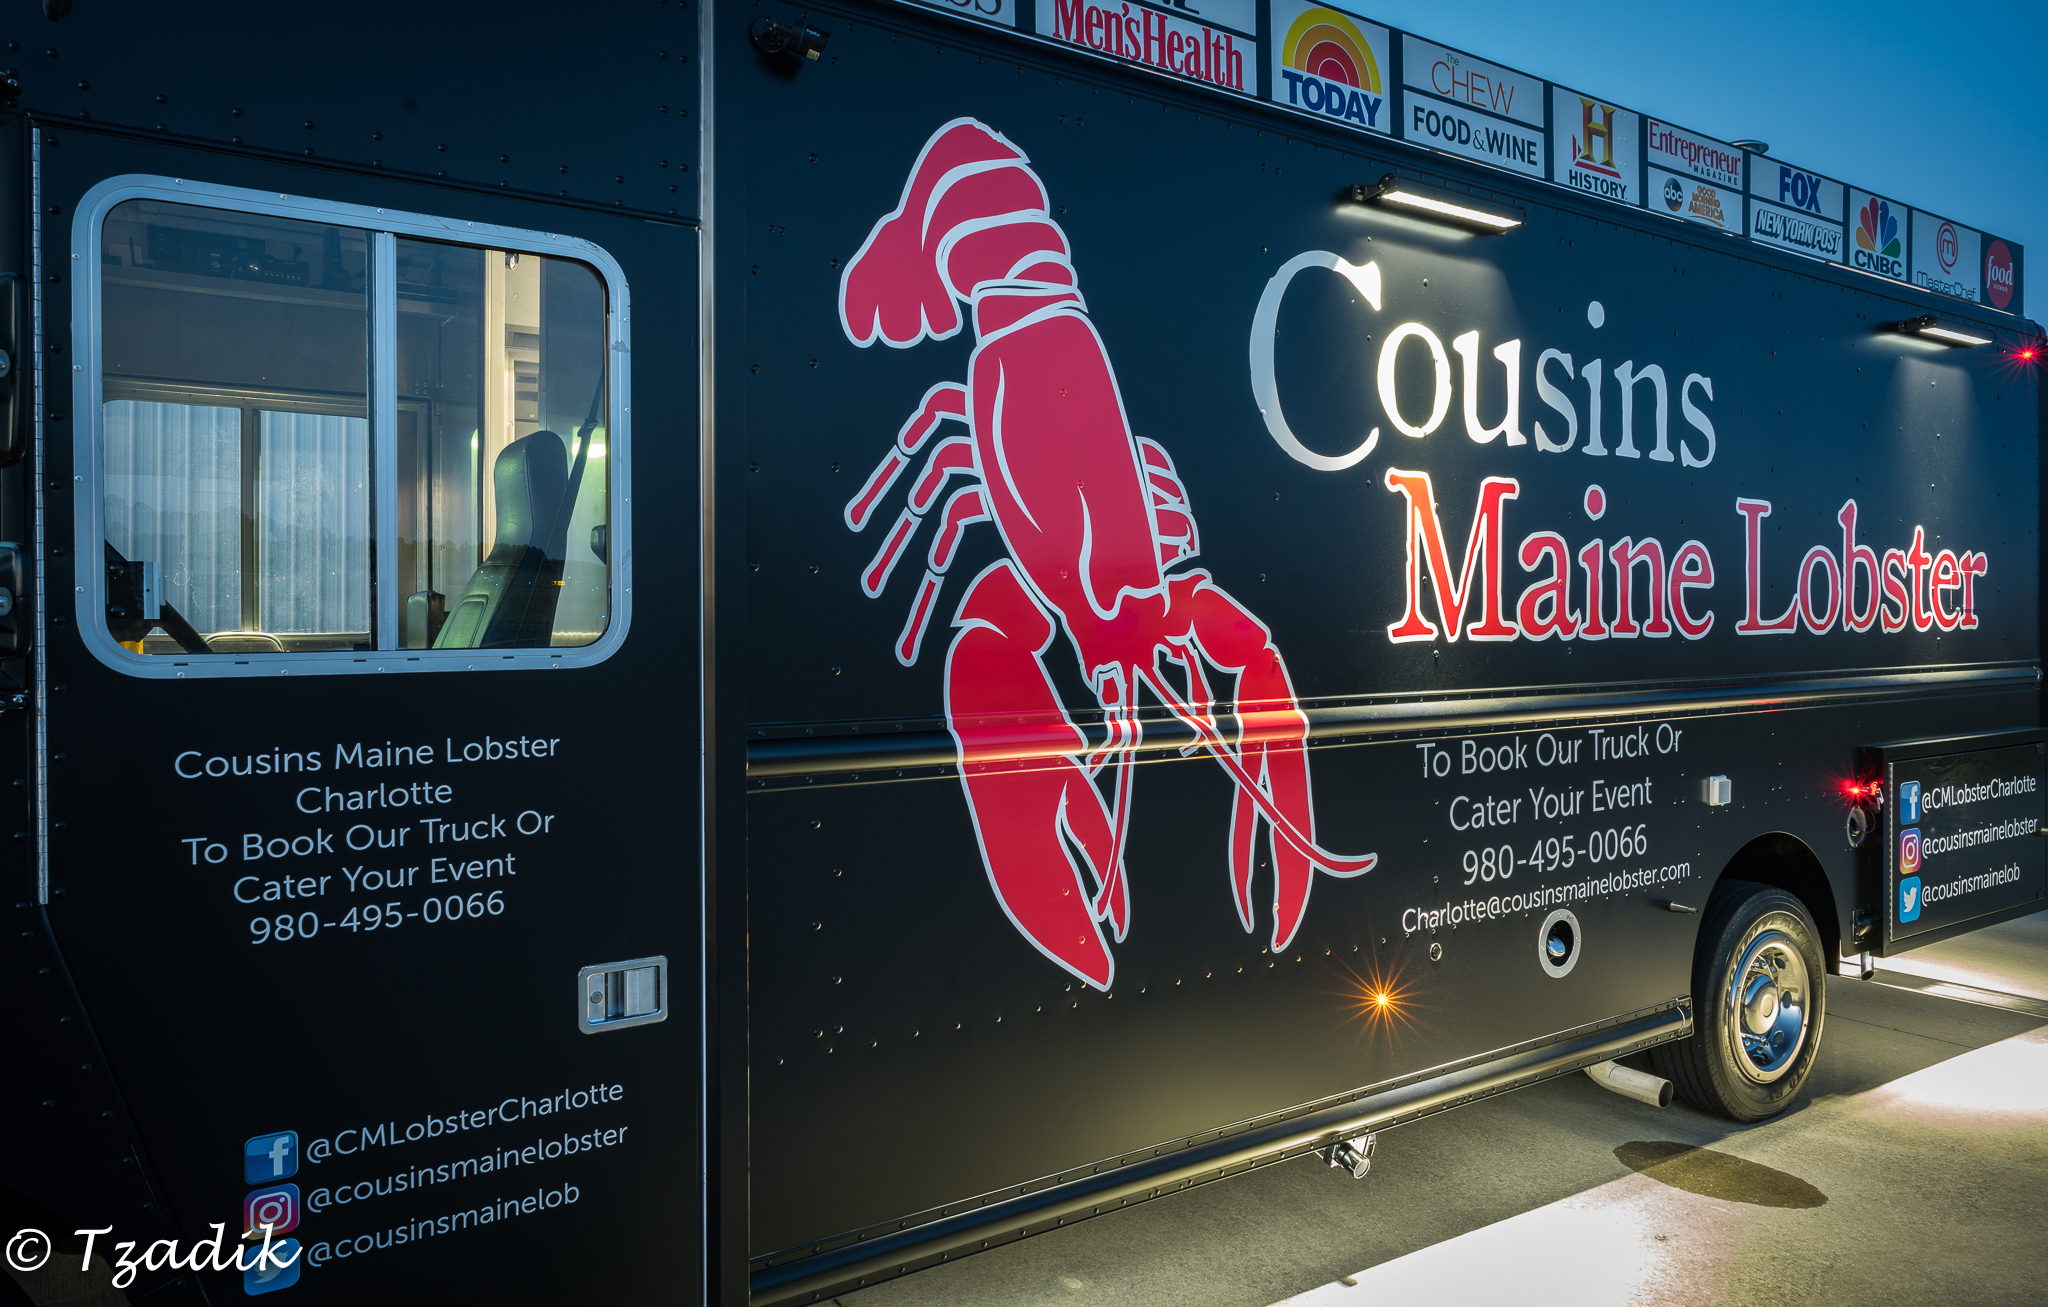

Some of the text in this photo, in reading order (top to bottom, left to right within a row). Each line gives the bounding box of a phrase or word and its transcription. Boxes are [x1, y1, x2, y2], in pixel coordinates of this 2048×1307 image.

[1445, 53, 1460, 66] The
[1282, 69, 1382, 127] TODAY
[1431, 60, 1515, 115] CHEW
[1648, 120, 1742, 175] Entrepreneur
[1568, 169, 1628, 200] HISTORY
[1664, 185, 1683, 203] abc
[1693, 164, 1738, 186] MAGAZINE
[1696, 184, 1716, 199] GOOD
[1779, 165, 1822, 214] FOX
[1687, 200, 1725, 222] AMERICA
[1692, 192, 1721, 209] MORNING
[1755, 209, 1842, 256] NEW YORK POST
[1854, 250, 1903, 278] CNBC
[1986, 255, 2013, 289] food
[1993, 283, 2009, 293] network
[1249, 250, 1716, 471] Cousins
[1384, 466, 1988, 644] Maine Lobster
[174, 735, 560, 779] Cousins Maine Lobster
[1416, 723, 1683, 778] To Book Our Truck Or
[296, 781, 453, 814] Charlotte
[1450, 777, 1653, 831] Cater Your Event
[1921, 775, 2036, 813] @CMLobsterCharlotte
[182, 810, 555, 866] To Book Our Truck Or
[1463, 824, 1647, 886] 980-495-0066
[1921, 818, 2038, 859] @cousinsmainelobster
[233, 851, 516, 904] Cater Your Event
[1402, 860, 1691, 934] Charlotte@cousinsmainelobster.com
[1921, 862, 2021, 907] @cousinsmainelob
[249, 890, 506, 945] 980-495-0066
[306, 1079, 624, 1164] @CMLobsterCharlotte
[306, 1123, 628, 1213] @cousinsmainelobster
[306, 1182, 581, 1268] @cousinsmainelob
